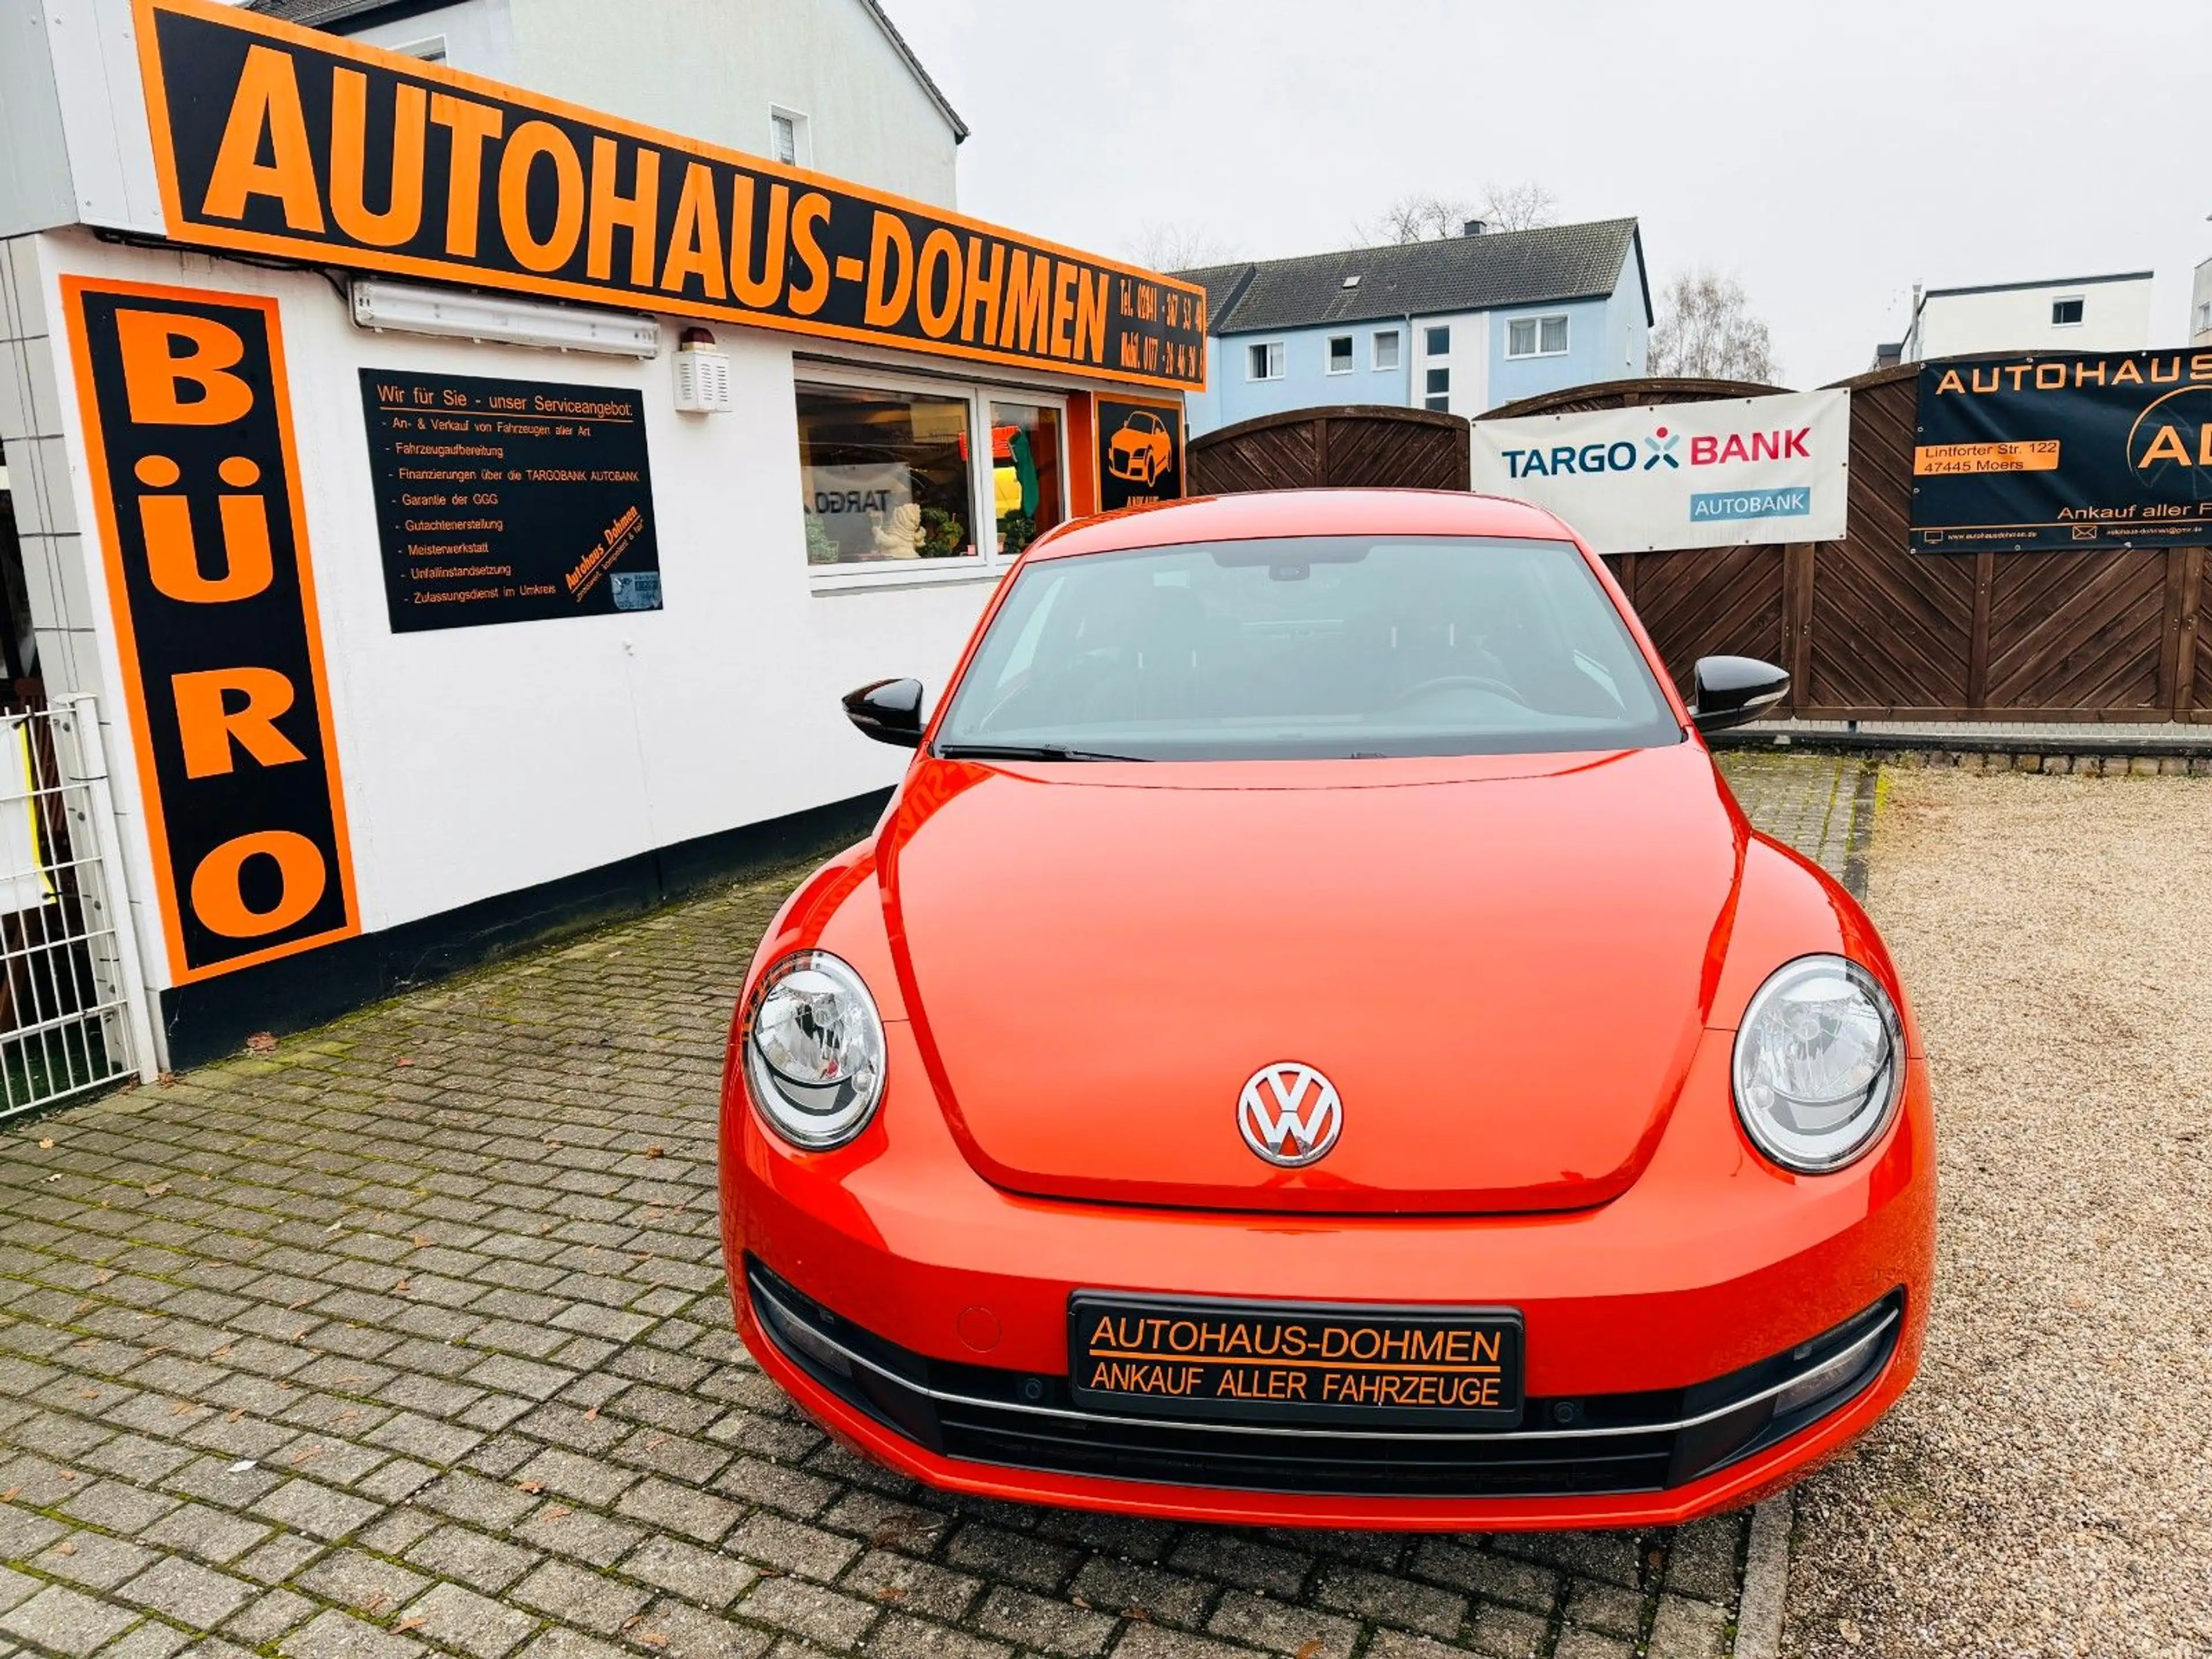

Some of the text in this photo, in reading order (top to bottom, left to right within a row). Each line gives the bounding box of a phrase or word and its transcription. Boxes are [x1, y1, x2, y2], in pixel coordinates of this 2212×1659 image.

[202, 44, 1109, 363] AUTOHAUS-DOHMEN
[377, 384, 405, 403] Wir
[414, 387, 434, 404] für
[443, 389, 468, 407] Sie
[489, 395, 527, 410] unser
[535, 395, 633, 418] Serviceangebot:
[392, 417, 591, 437] An- & Verkauf von Fahrzeugen aller Art
[395, 442, 504, 459] Fahrzeugaufbereitung
[1501, 427, 1811, 479] TARGO BANK
[1925, 442, 2058, 459] Lintforter Str. 122
[399, 468, 640, 482] Finanzierungen über die TARGOBANK AUTOBANK
[1924, 460, 2024, 472] 47445 Moers
[402, 493, 499, 506] Garantie der GGG
[1695, 493, 1805, 517] AUTOBANK
[2057, 505, 2138, 519] Ankauf
[2142, 504, 2192, 517] aller
[405, 518, 504, 532] Gutachtenerstellung
[408, 542, 490, 555] Meisterwerkstatt
[565, 543, 605, 590] Autohaus
[604, 505, 639, 546] Dohmen
[411, 565, 512, 579] Unfallinstandsetzung
[414, 584, 557, 604] Zulassungsdienst im Umkreis
[115, 308, 326, 937] BÜRO
[1090, 1315, 1502, 1362] AUTOHAUS-DOHMEN
[1090, 1362, 1501, 1406] ANKAUF ALLER FAHRZEUGE
